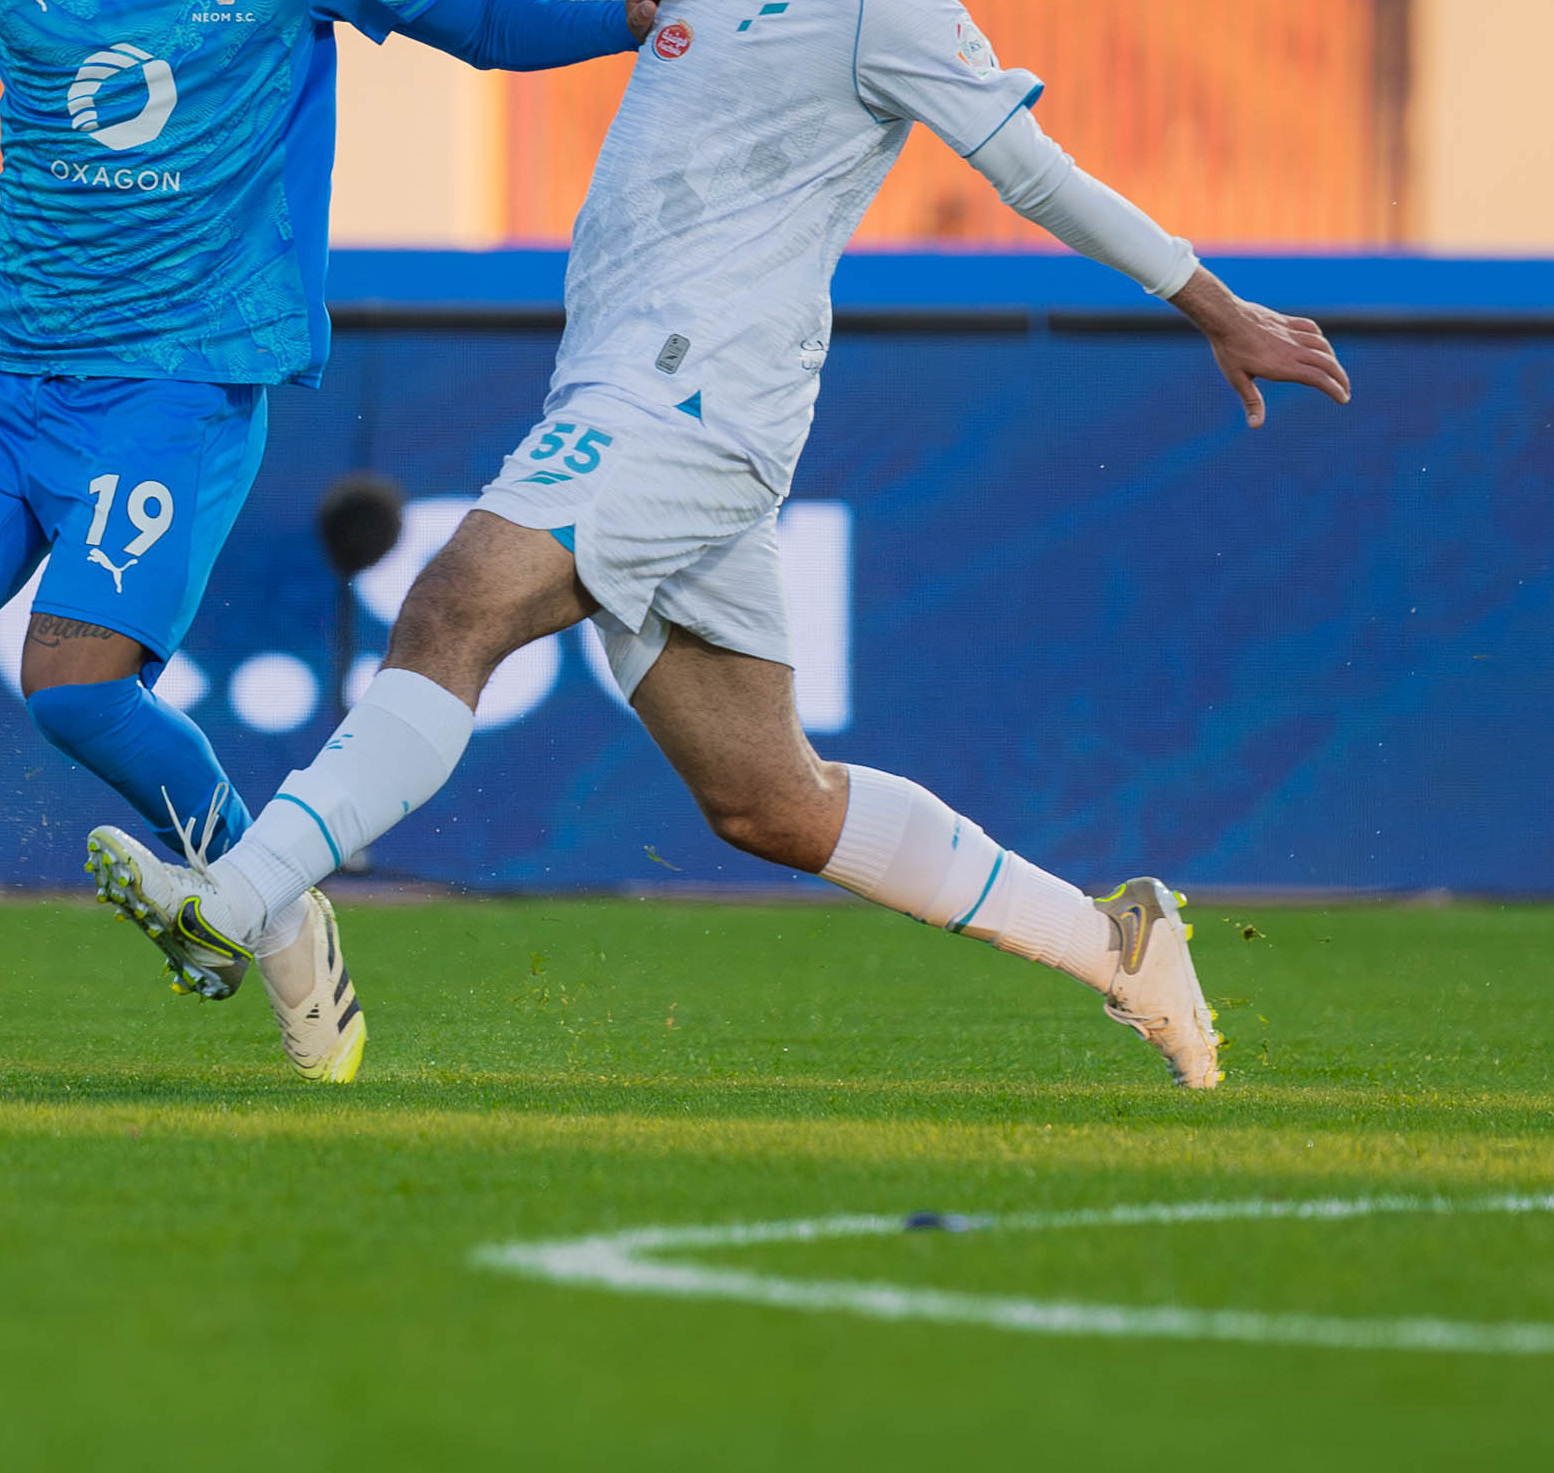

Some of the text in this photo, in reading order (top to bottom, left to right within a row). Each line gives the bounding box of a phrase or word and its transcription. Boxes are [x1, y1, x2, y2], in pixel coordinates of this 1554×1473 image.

[191, 12, 231, 23] NEOM
[51, 159, 181, 192] OXAGON
[529, 422, 614, 475] 55
[85, 473, 175, 557] 19
